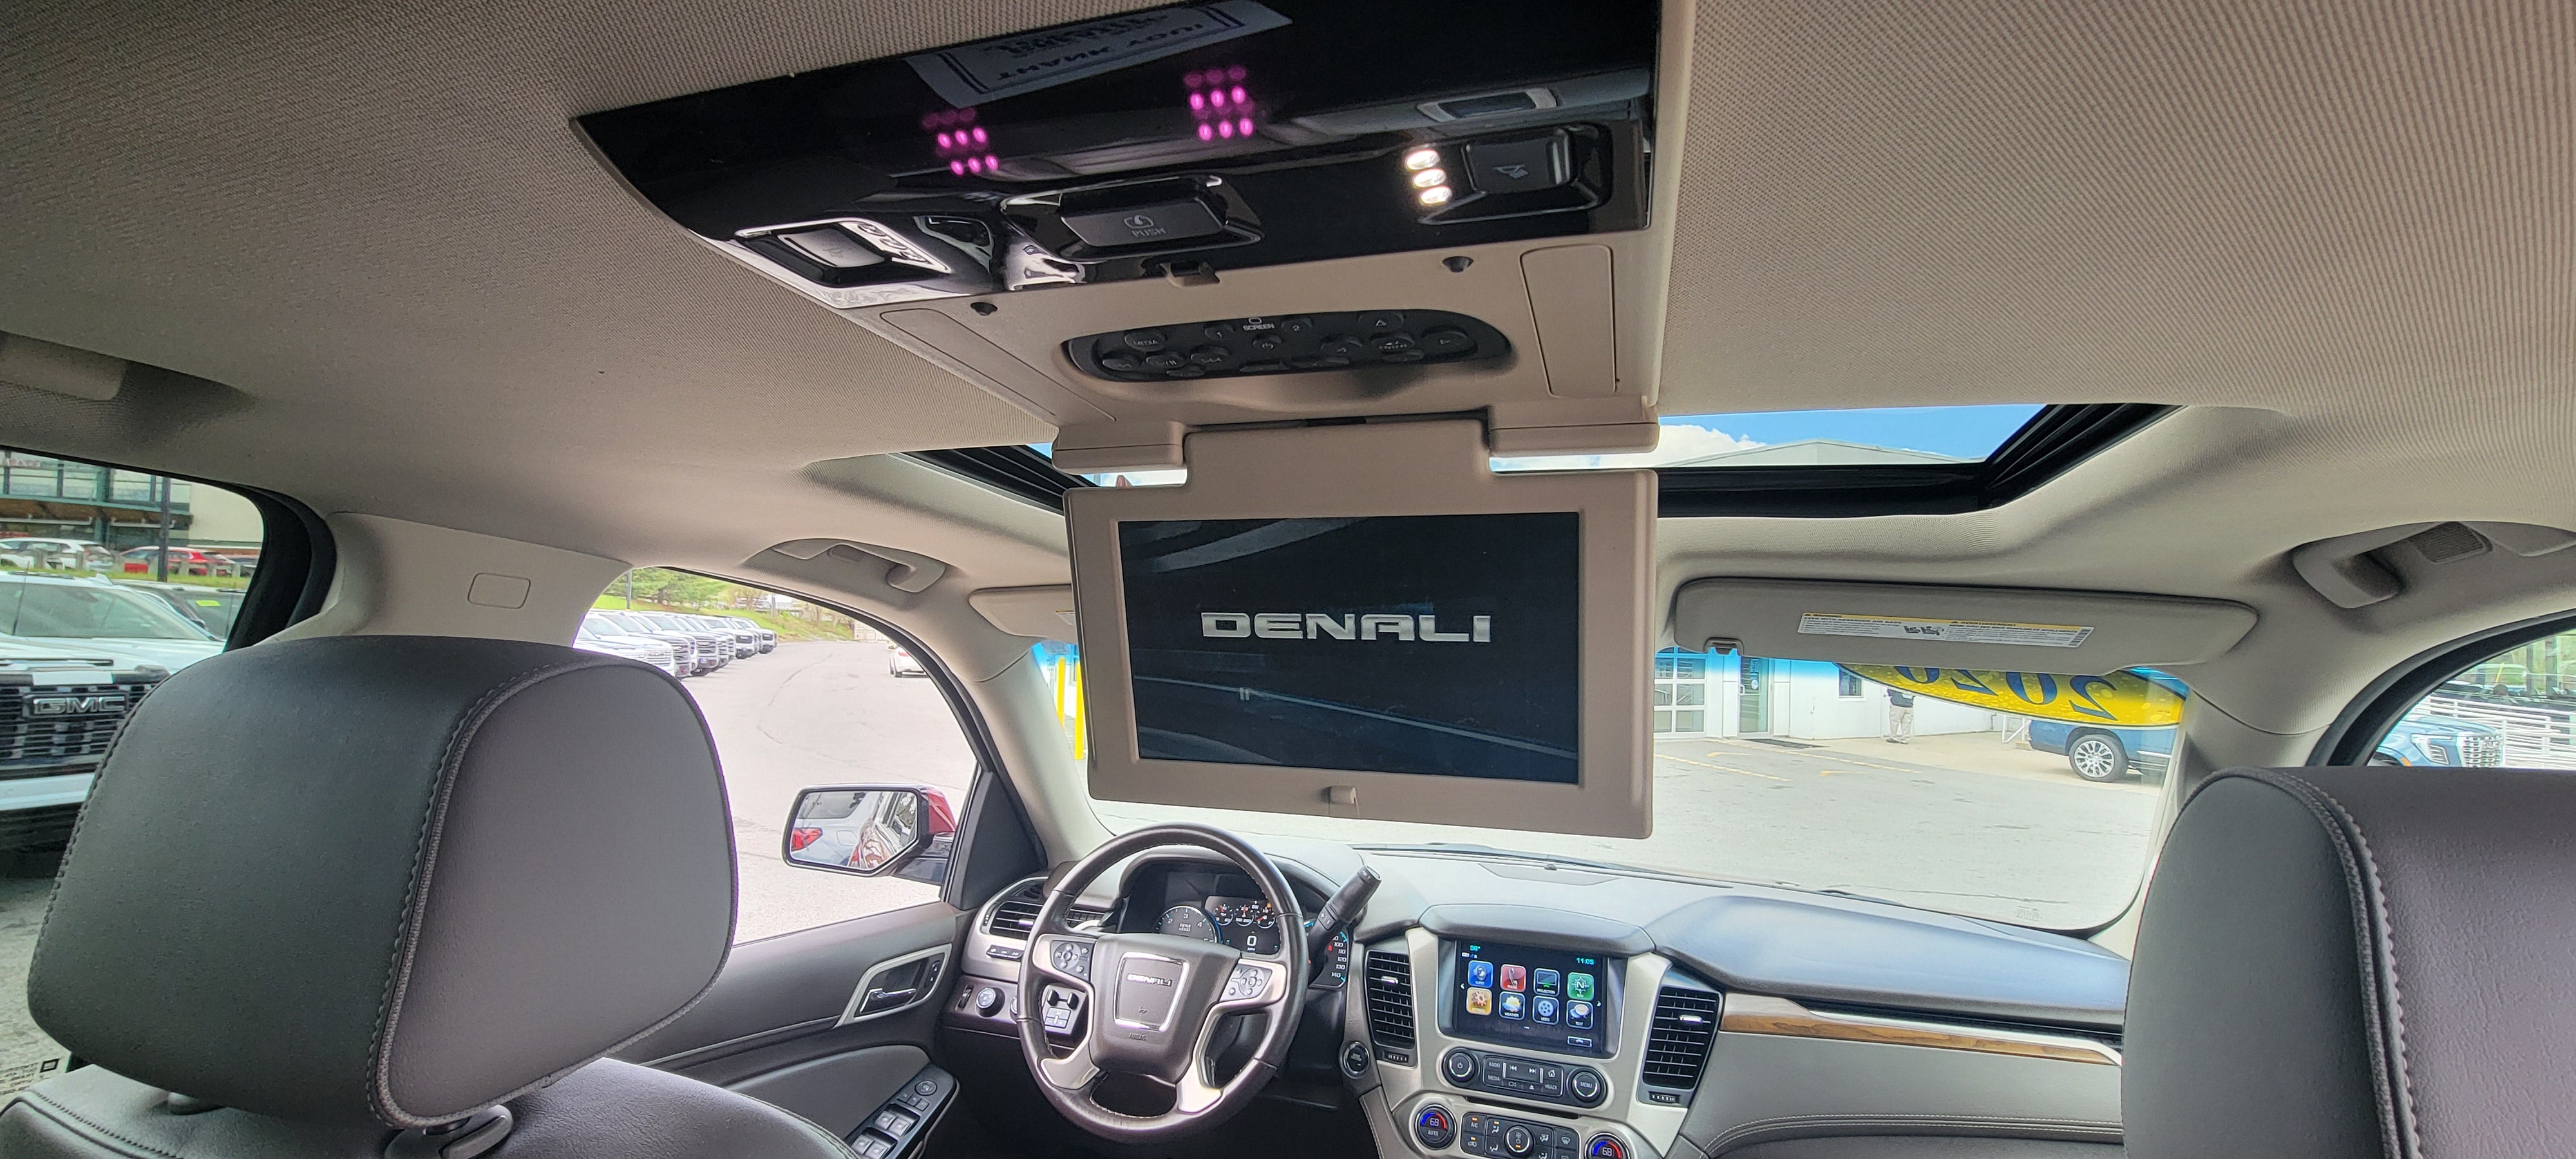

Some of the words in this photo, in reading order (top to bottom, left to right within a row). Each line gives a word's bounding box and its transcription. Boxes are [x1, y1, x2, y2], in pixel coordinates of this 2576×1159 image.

[1131, 228, 1168, 238] PUSH
[1242, 323, 1275, 332] SCREEN
[1200, 612, 1492, 643] DENALI
[33, 696, 126, 715] GMC
[1247, 935, 1257, 947] 0
[1127, 973, 1173, 987] DENALI
[1430, 1118, 1439, 1127] 68
[1602, 1147, 1613, 1156] 68
